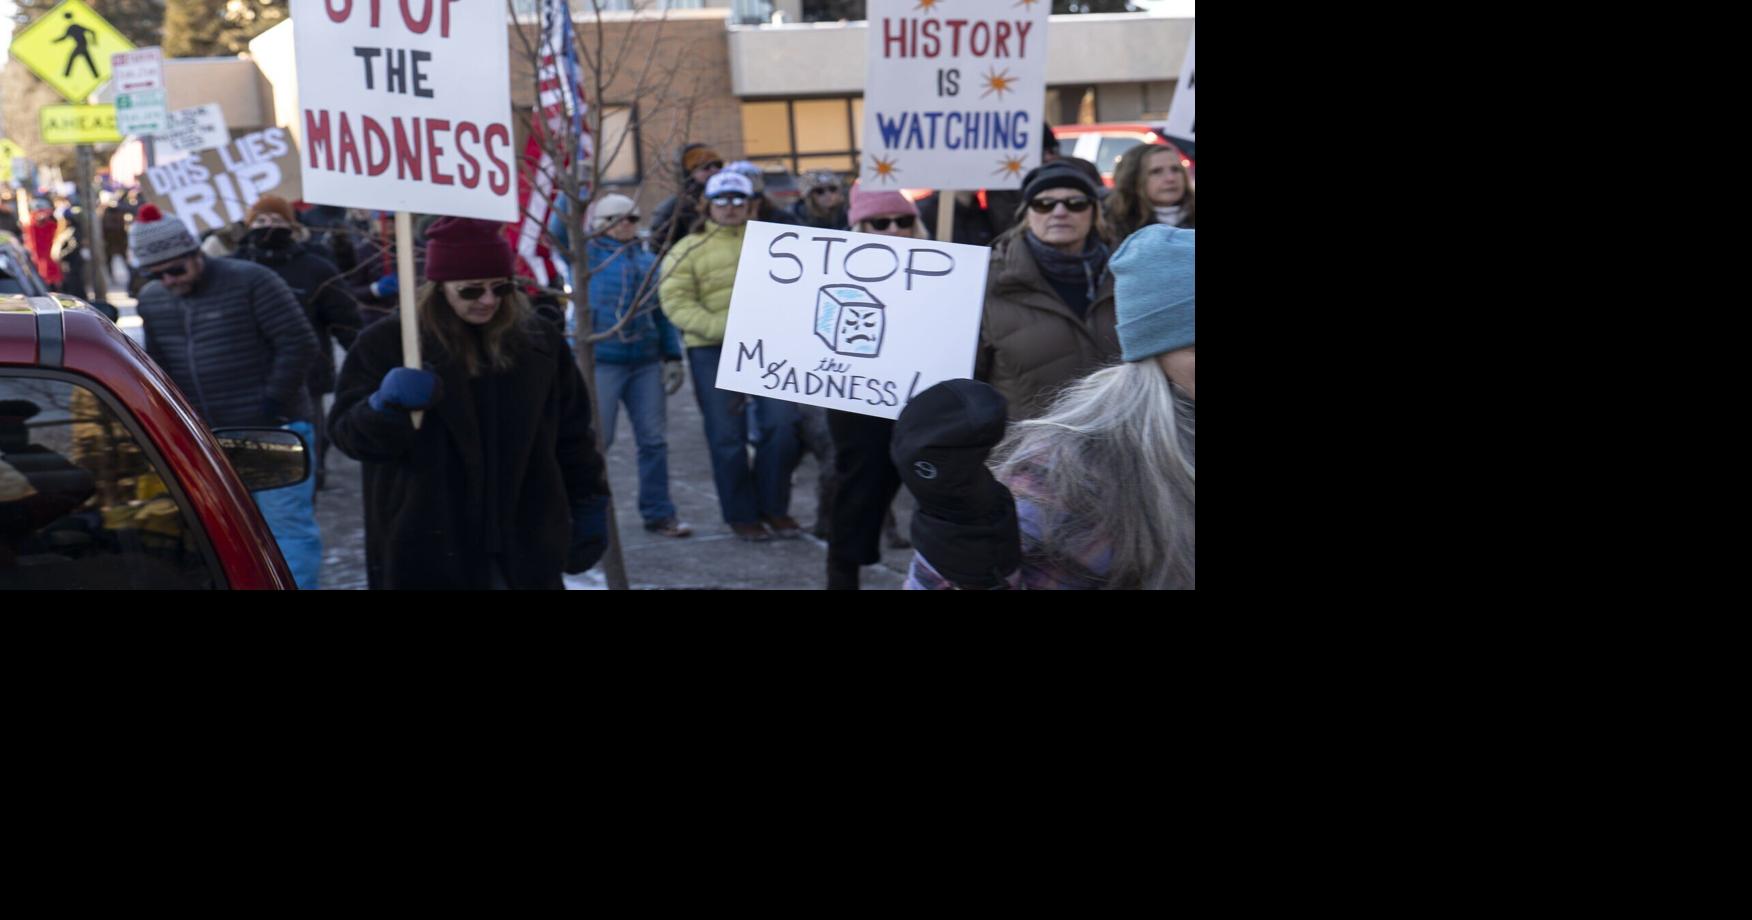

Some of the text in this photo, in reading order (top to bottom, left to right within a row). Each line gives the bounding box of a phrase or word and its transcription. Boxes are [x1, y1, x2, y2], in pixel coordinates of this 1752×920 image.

[883, 18, 1033, 59] HISTORY
[353, 47, 435, 99] THE
[937, 68, 961, 97] IS
[305, 109, 510, 196] MADNESS
[876, 111, 1029, 150] WATCHING
[147, 153, 210, 196] DHS
[216, 126, 289, 172] LIES
[169, 158, 282, 240] RIP
[768, 231, 955, 291] STOP
[813, 357, 851, 374] the
